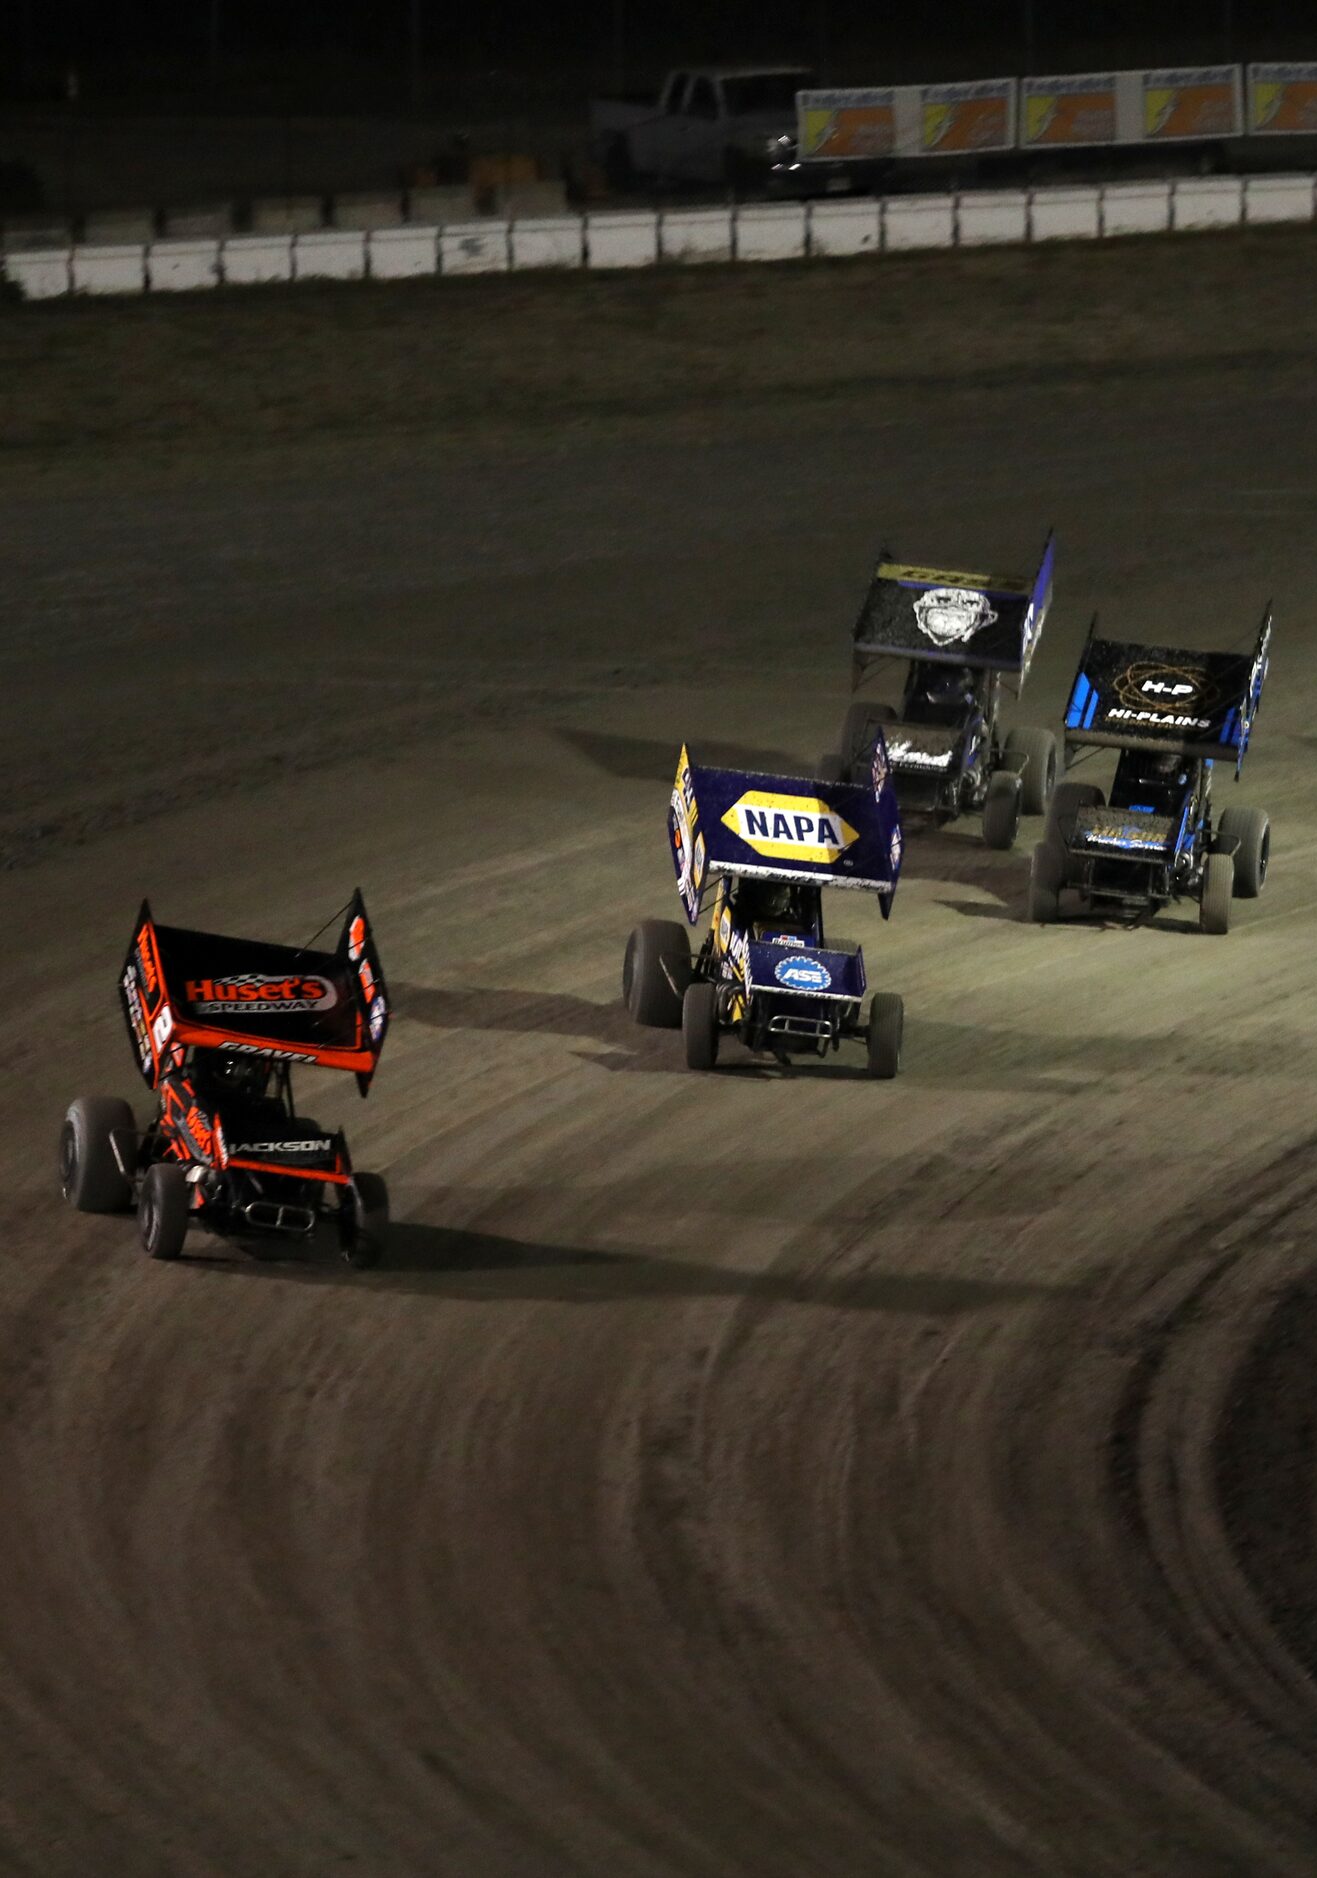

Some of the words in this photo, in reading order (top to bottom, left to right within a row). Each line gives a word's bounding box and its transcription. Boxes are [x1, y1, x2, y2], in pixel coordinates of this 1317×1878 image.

[1141, 680, 1194, 696] H-P
[1107, 708, 1212, 728] HI-PLAINS
[745, 809, 839, 845] NAPA
[783, 968, 823, 984] ASE
[185, 976, 326, 1002] Huset's
[209, 1000, 321, 1012] SPEEDWAY
[218, 1041, 320, 1064] GRAVEL
[228, 1139, 331, 1155] JACKSON
